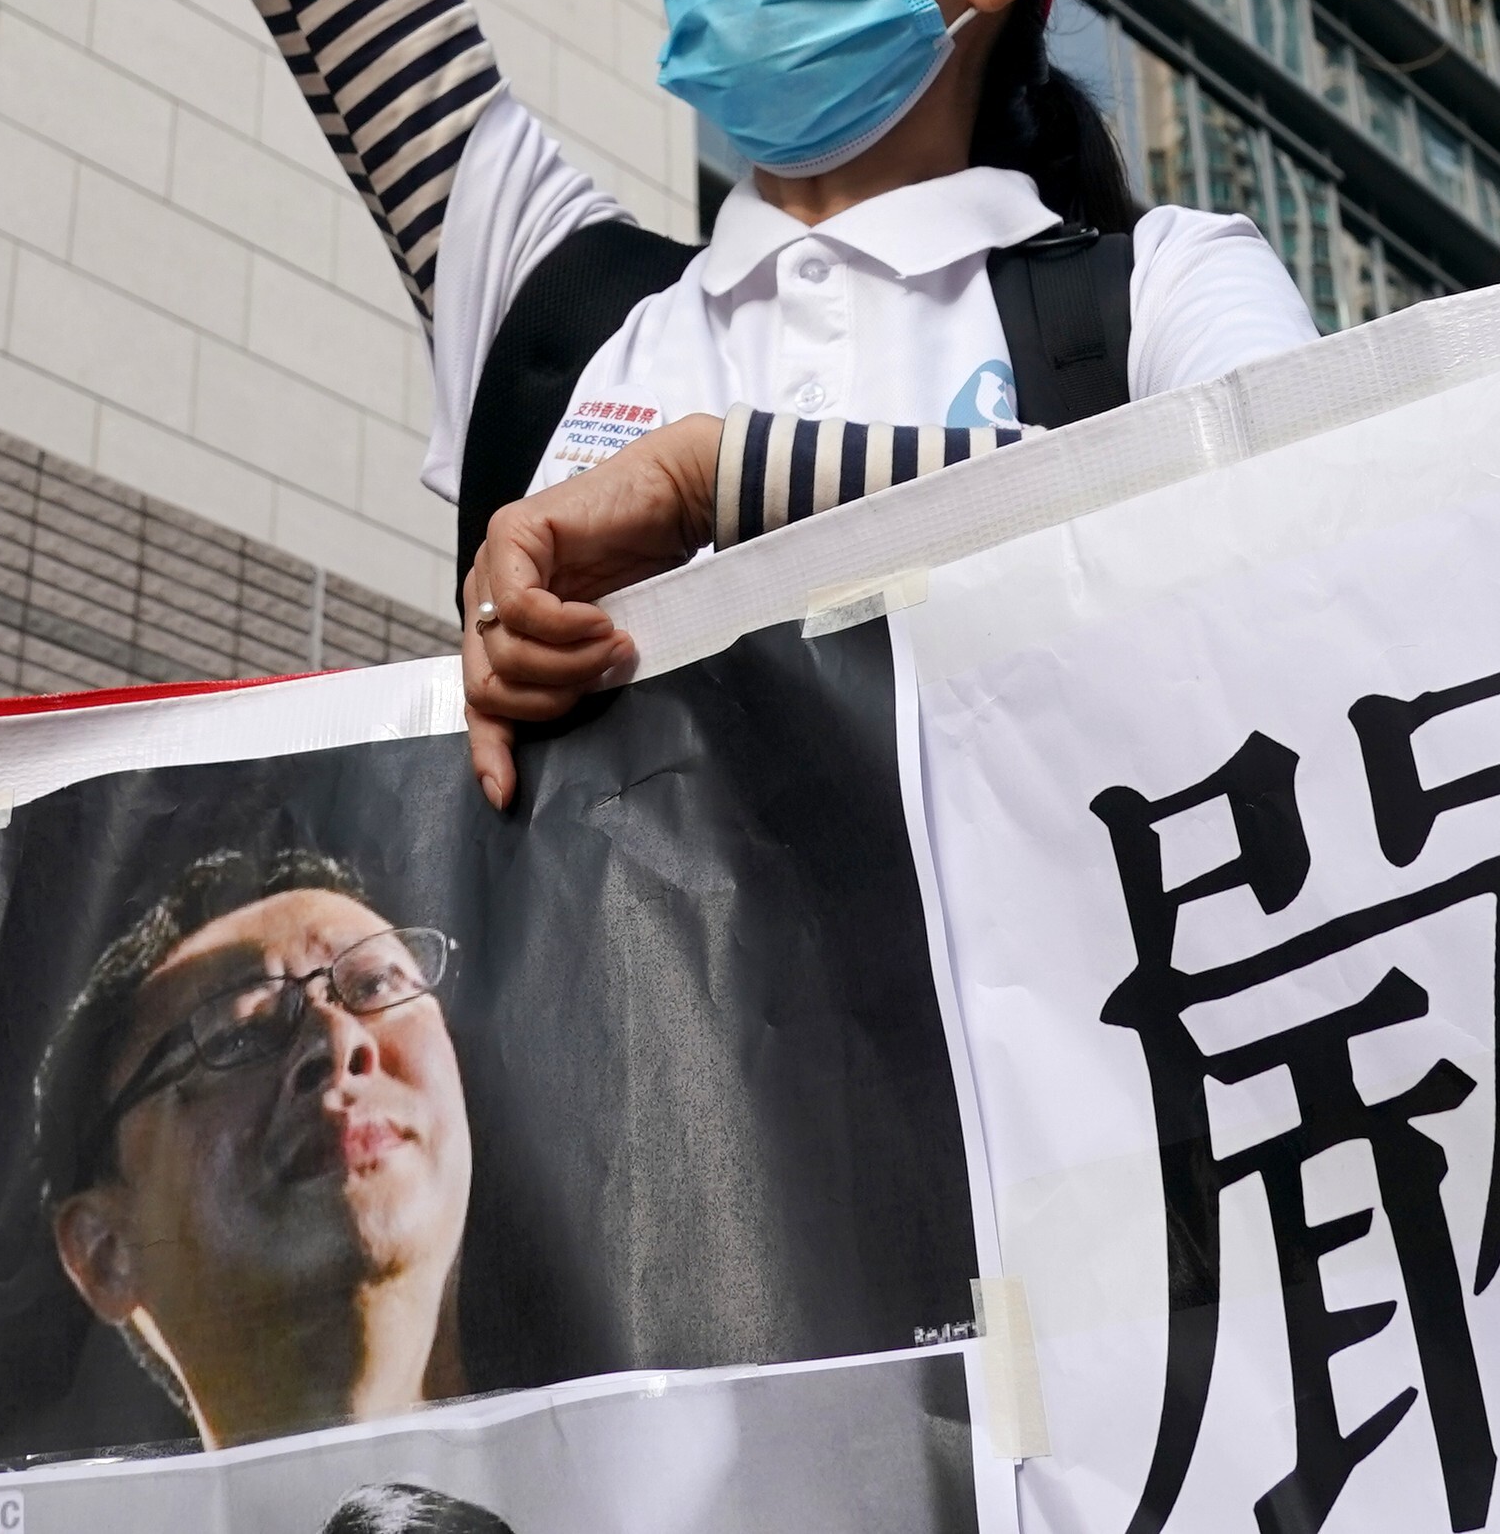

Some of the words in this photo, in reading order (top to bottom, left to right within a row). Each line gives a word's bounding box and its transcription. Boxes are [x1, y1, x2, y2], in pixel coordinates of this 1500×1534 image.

[574, 401, 658, 423] 支持香港警察
[560, 419, 597, 429] SUPPORT
[599, 421, 624, 435] HONG
[624, 426, 652, 438] KON
[566, 432, 598, 445] POLICE
